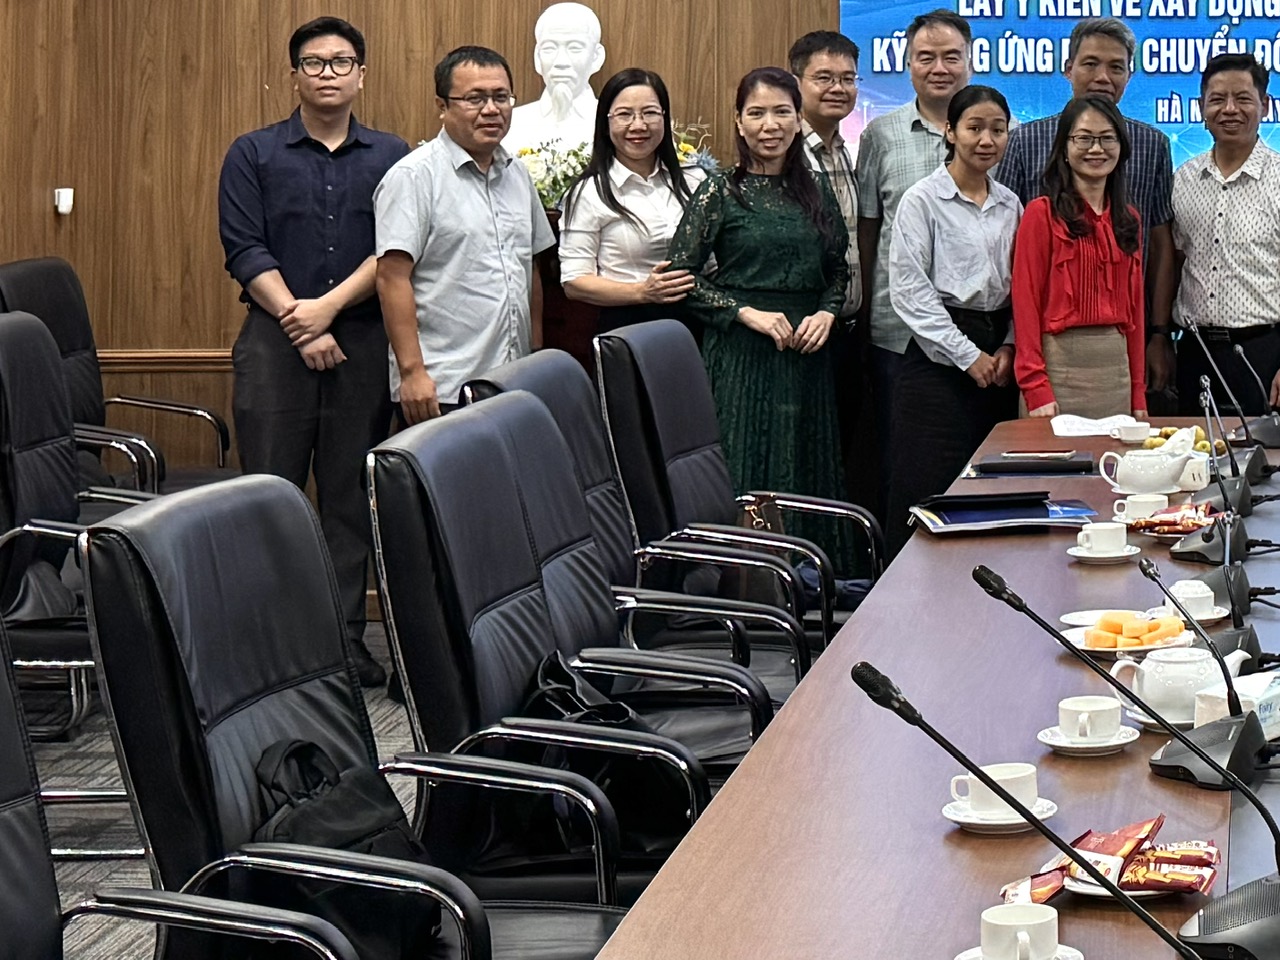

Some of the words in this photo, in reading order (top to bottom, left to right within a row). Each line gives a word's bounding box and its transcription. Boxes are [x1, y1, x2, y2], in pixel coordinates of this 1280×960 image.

[872, 30, 908, 73] KỸ
[998, 31, 1055, 73] ỨNG
[1157, 93, 1183, 123] HÀ
